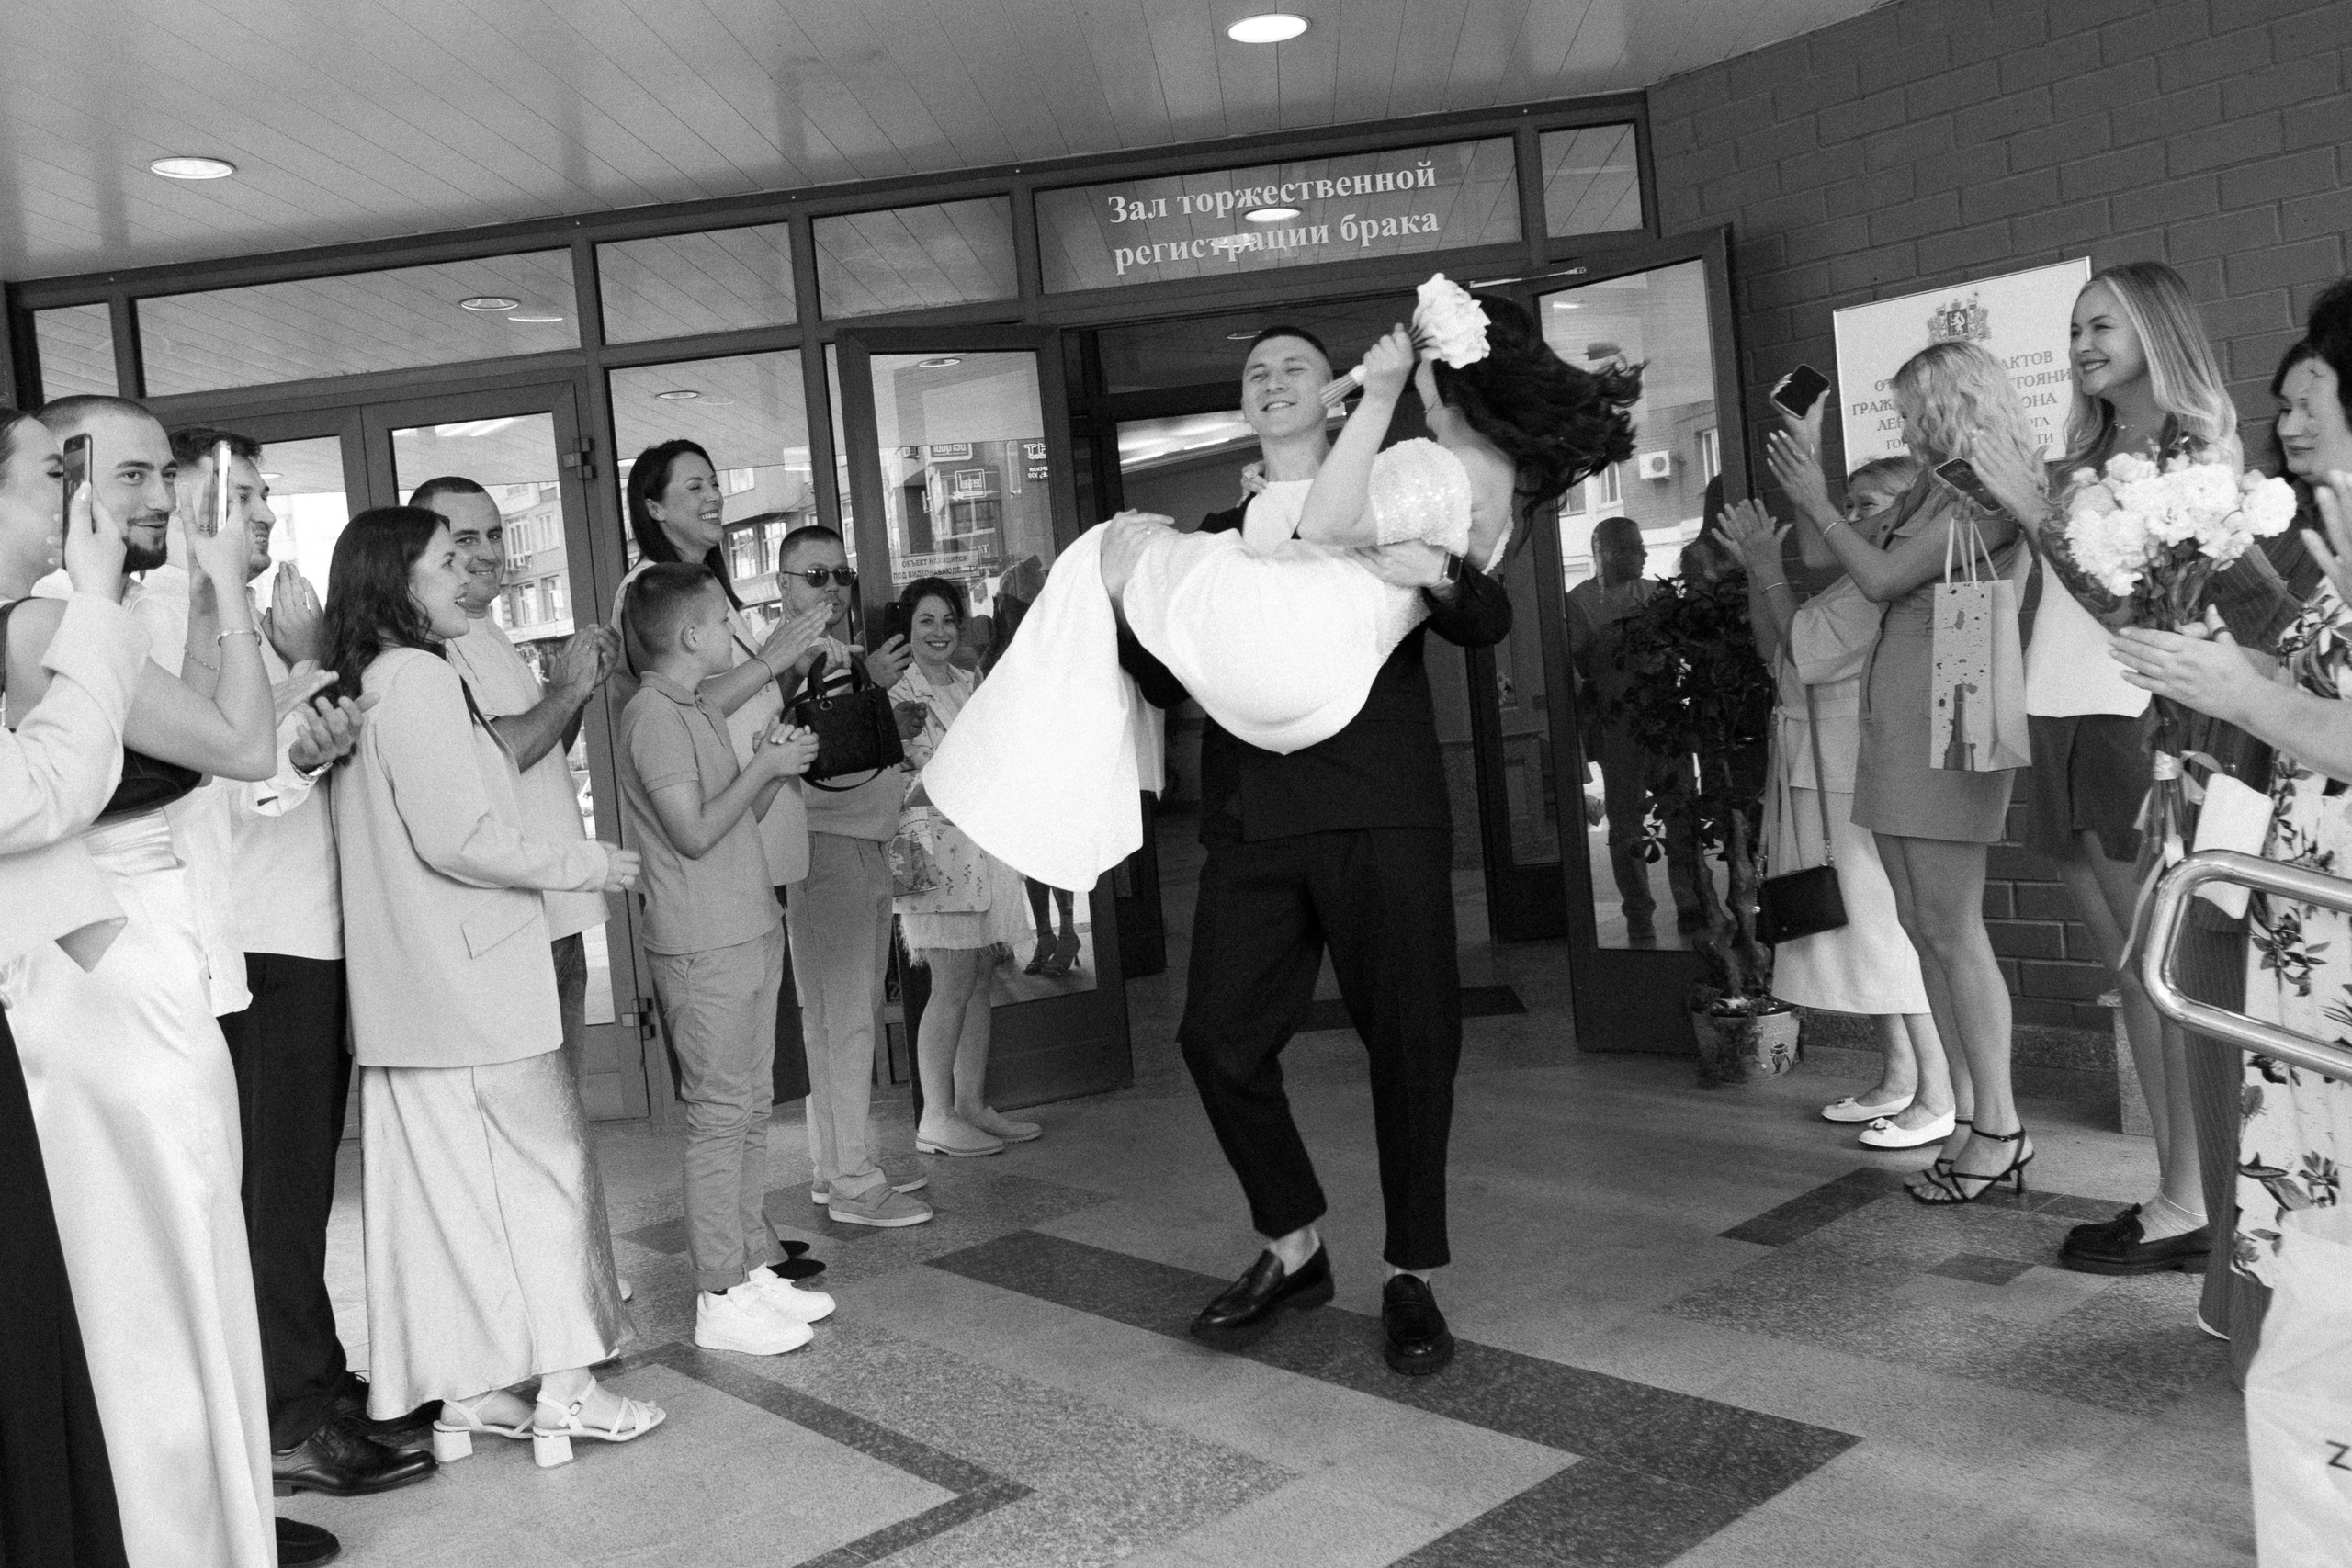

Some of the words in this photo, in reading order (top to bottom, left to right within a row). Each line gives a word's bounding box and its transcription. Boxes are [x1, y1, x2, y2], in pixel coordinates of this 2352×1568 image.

[1108, 194, 1168, 223] Зал
[1177, 160, 1437, 220] торжественной
[1114, 223, 1329, 276] регистрации
[1340, 211, 1441, 248] брака
[893, 571, 908, 581] ПОД
[901, 558, 928, 568] ОБЪЕКТ
